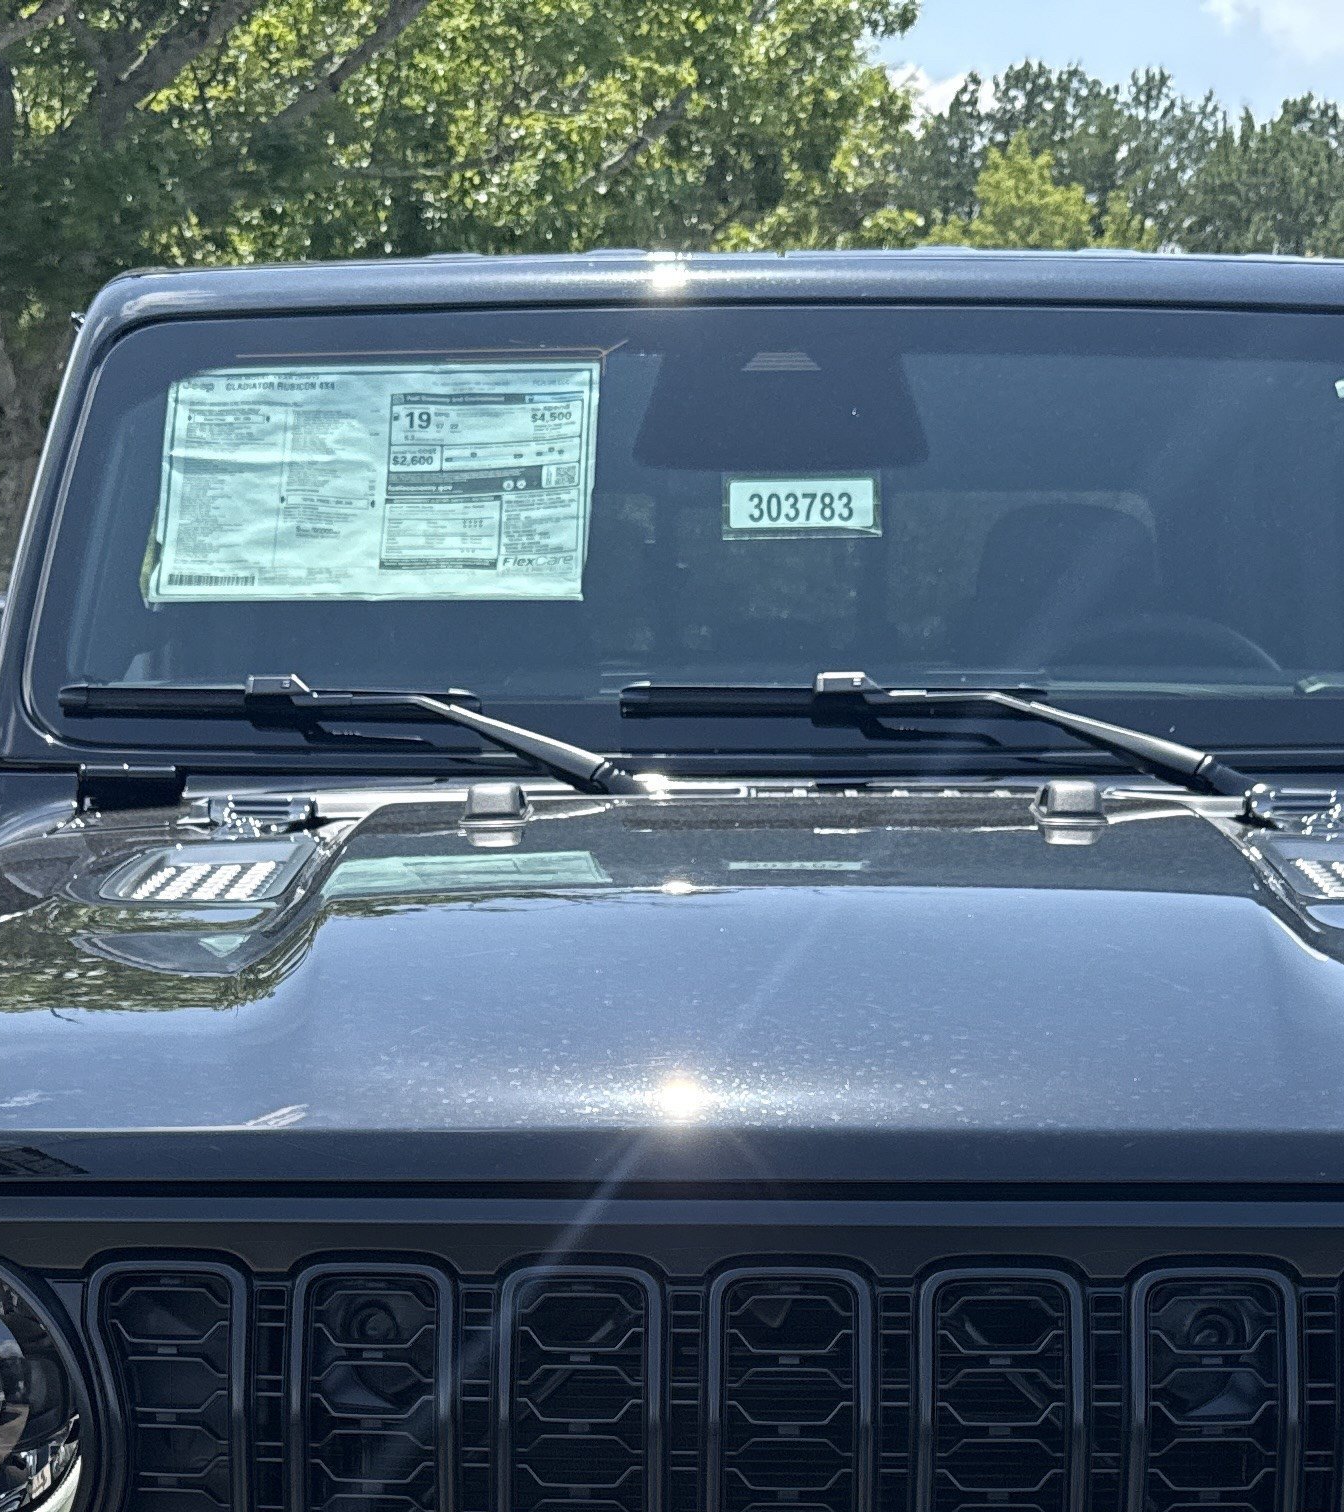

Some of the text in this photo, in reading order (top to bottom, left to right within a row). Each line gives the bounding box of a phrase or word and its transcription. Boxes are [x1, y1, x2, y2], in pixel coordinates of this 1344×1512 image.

[405, 411, 432, 429] 19
[531, 411, 572, 423] $4,500
[392, 456, 434, 467] $2,600
[748, 492, 854, 523] 303783
[502, 555, 574, 568] FlexCare
